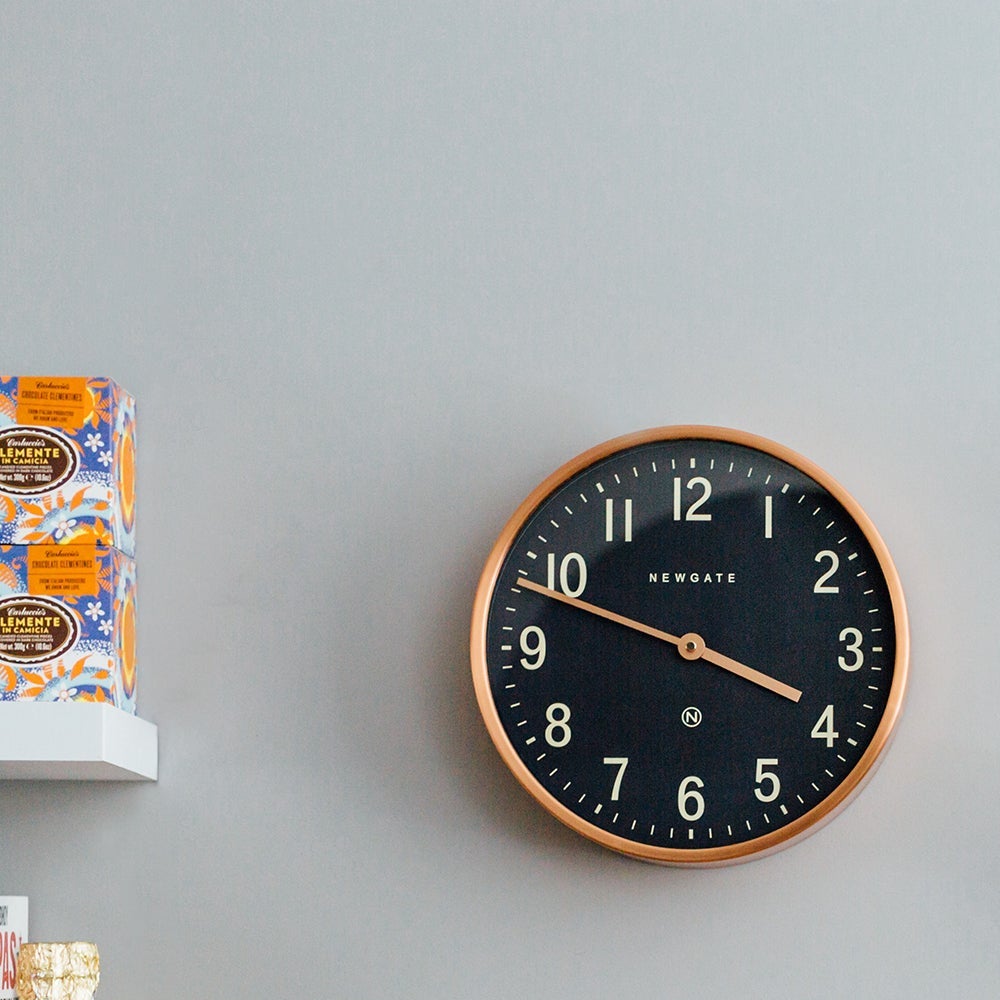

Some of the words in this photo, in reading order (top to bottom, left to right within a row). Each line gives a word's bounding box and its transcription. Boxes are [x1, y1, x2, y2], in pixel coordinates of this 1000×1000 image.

[606, 498, 632, 542] 11
[673, 476, 712, 521] 12
[764, 496, 772, 538] 1
[547, 552, 588, 598] 10
[649, 573, 736, 584] NEWGATE
[812, 550, 840, 594] 2
[519, 626, 546, 670] 9
[837, 627, 864, 672] 3
[544, 702, 572, 748] 8
[810, 704, 839, 748] 4
[603, 757, 629, 801] 7
[677, 776, 706, 822] 6
[754, 758, 780, 802] 5
